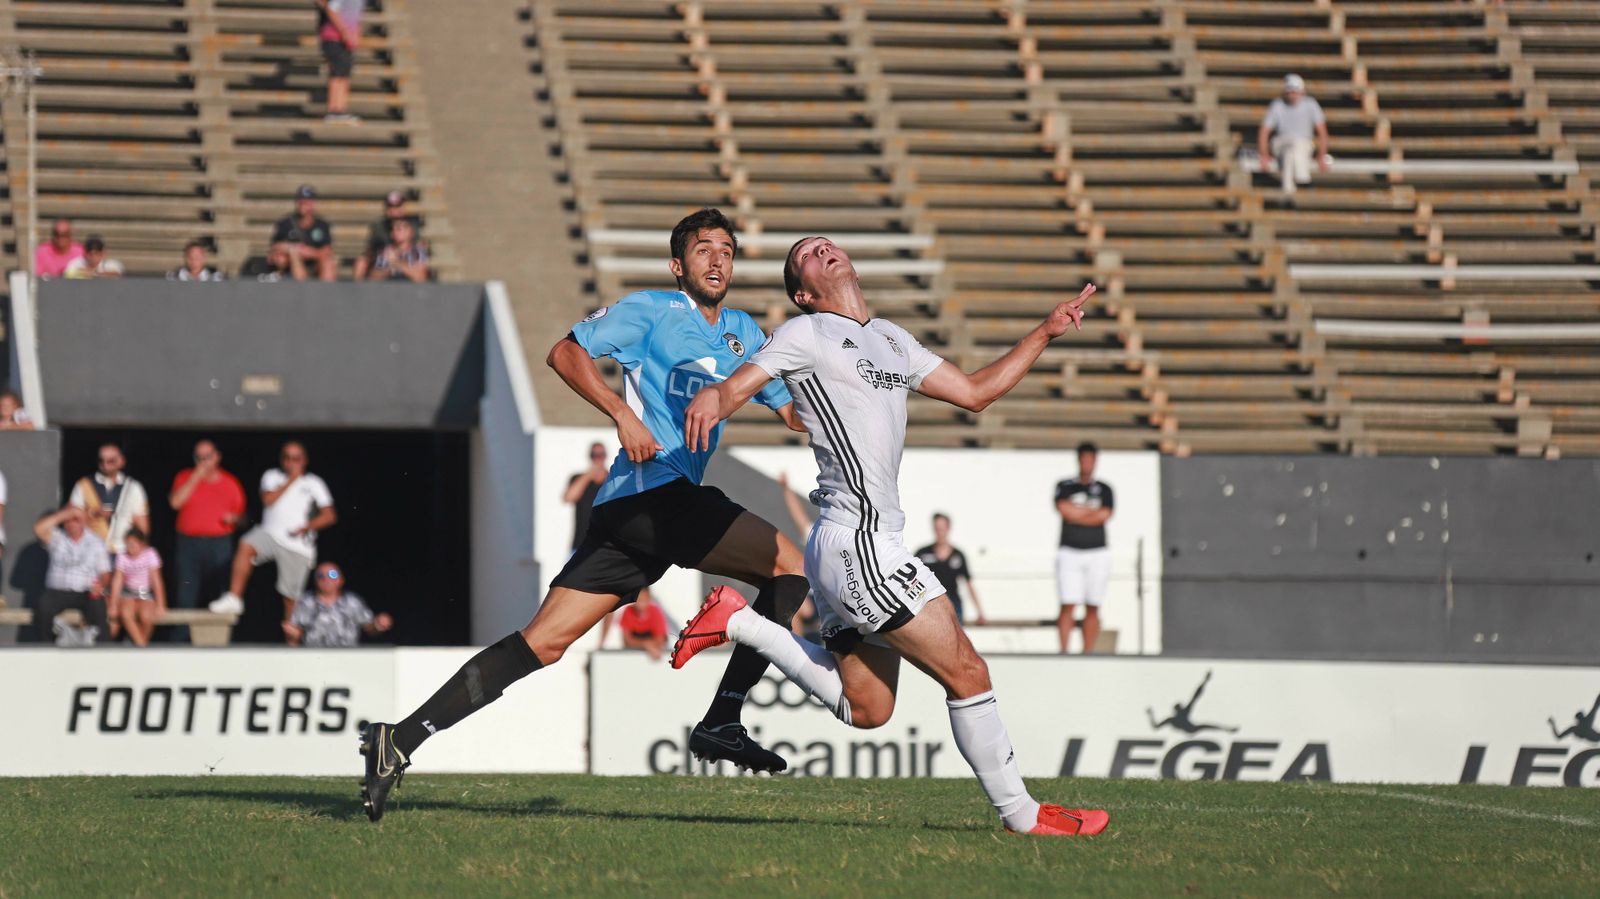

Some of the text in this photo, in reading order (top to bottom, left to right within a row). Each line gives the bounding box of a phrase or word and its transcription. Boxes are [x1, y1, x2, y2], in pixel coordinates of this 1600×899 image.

[668, 371, 714, 399] LO
[850, 727, 943, 778] mir
[1058, 737, 1333, 782] LEGEA
